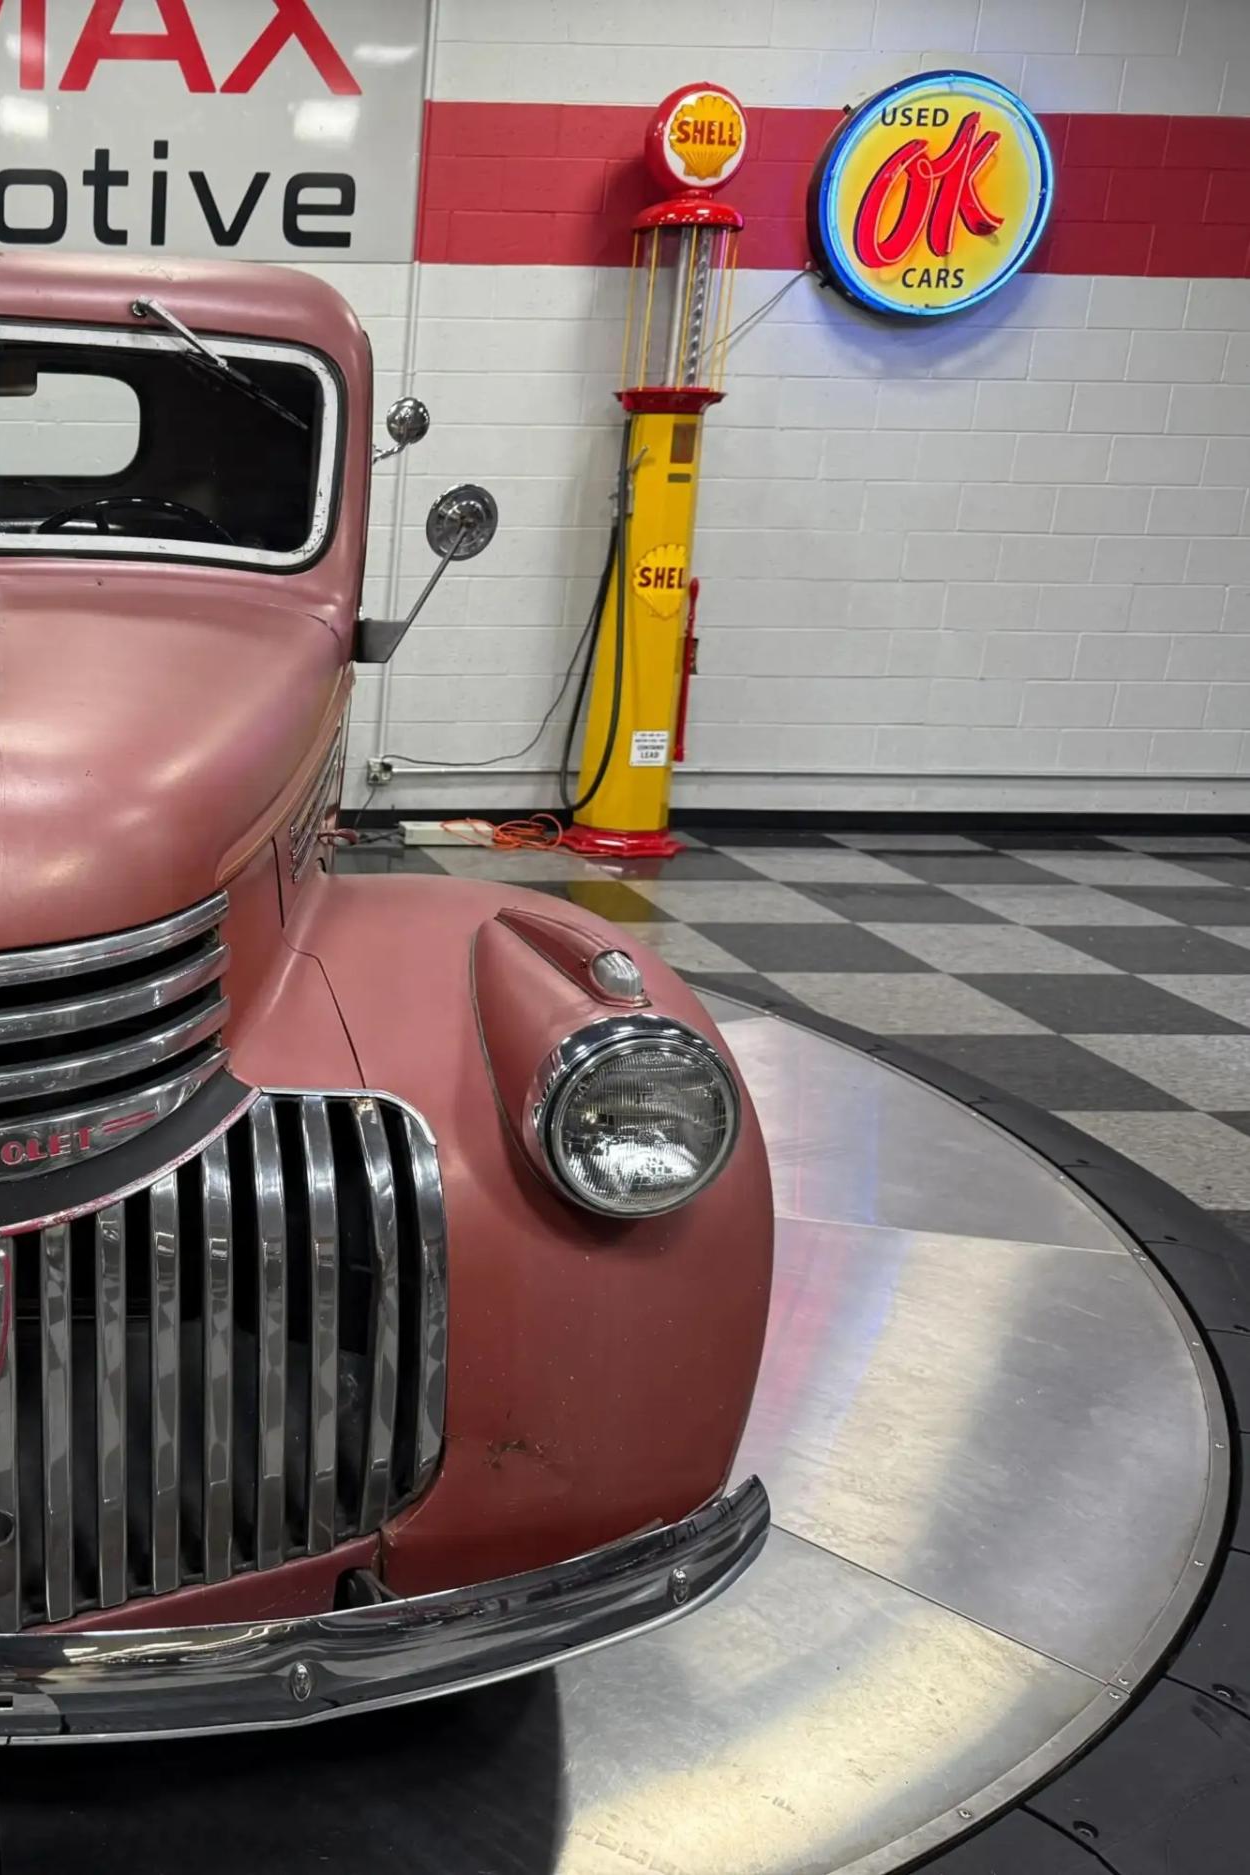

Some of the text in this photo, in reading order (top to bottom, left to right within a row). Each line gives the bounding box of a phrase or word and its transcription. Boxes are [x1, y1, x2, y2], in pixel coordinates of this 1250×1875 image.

[881, 107, 949, 128] USED
[675, 119, 738, 148] SHELL
[853, 111, 1004, 268] OK
[901, 268, 964, 289] CARS
[637, 566, 686, 589] SHEL
